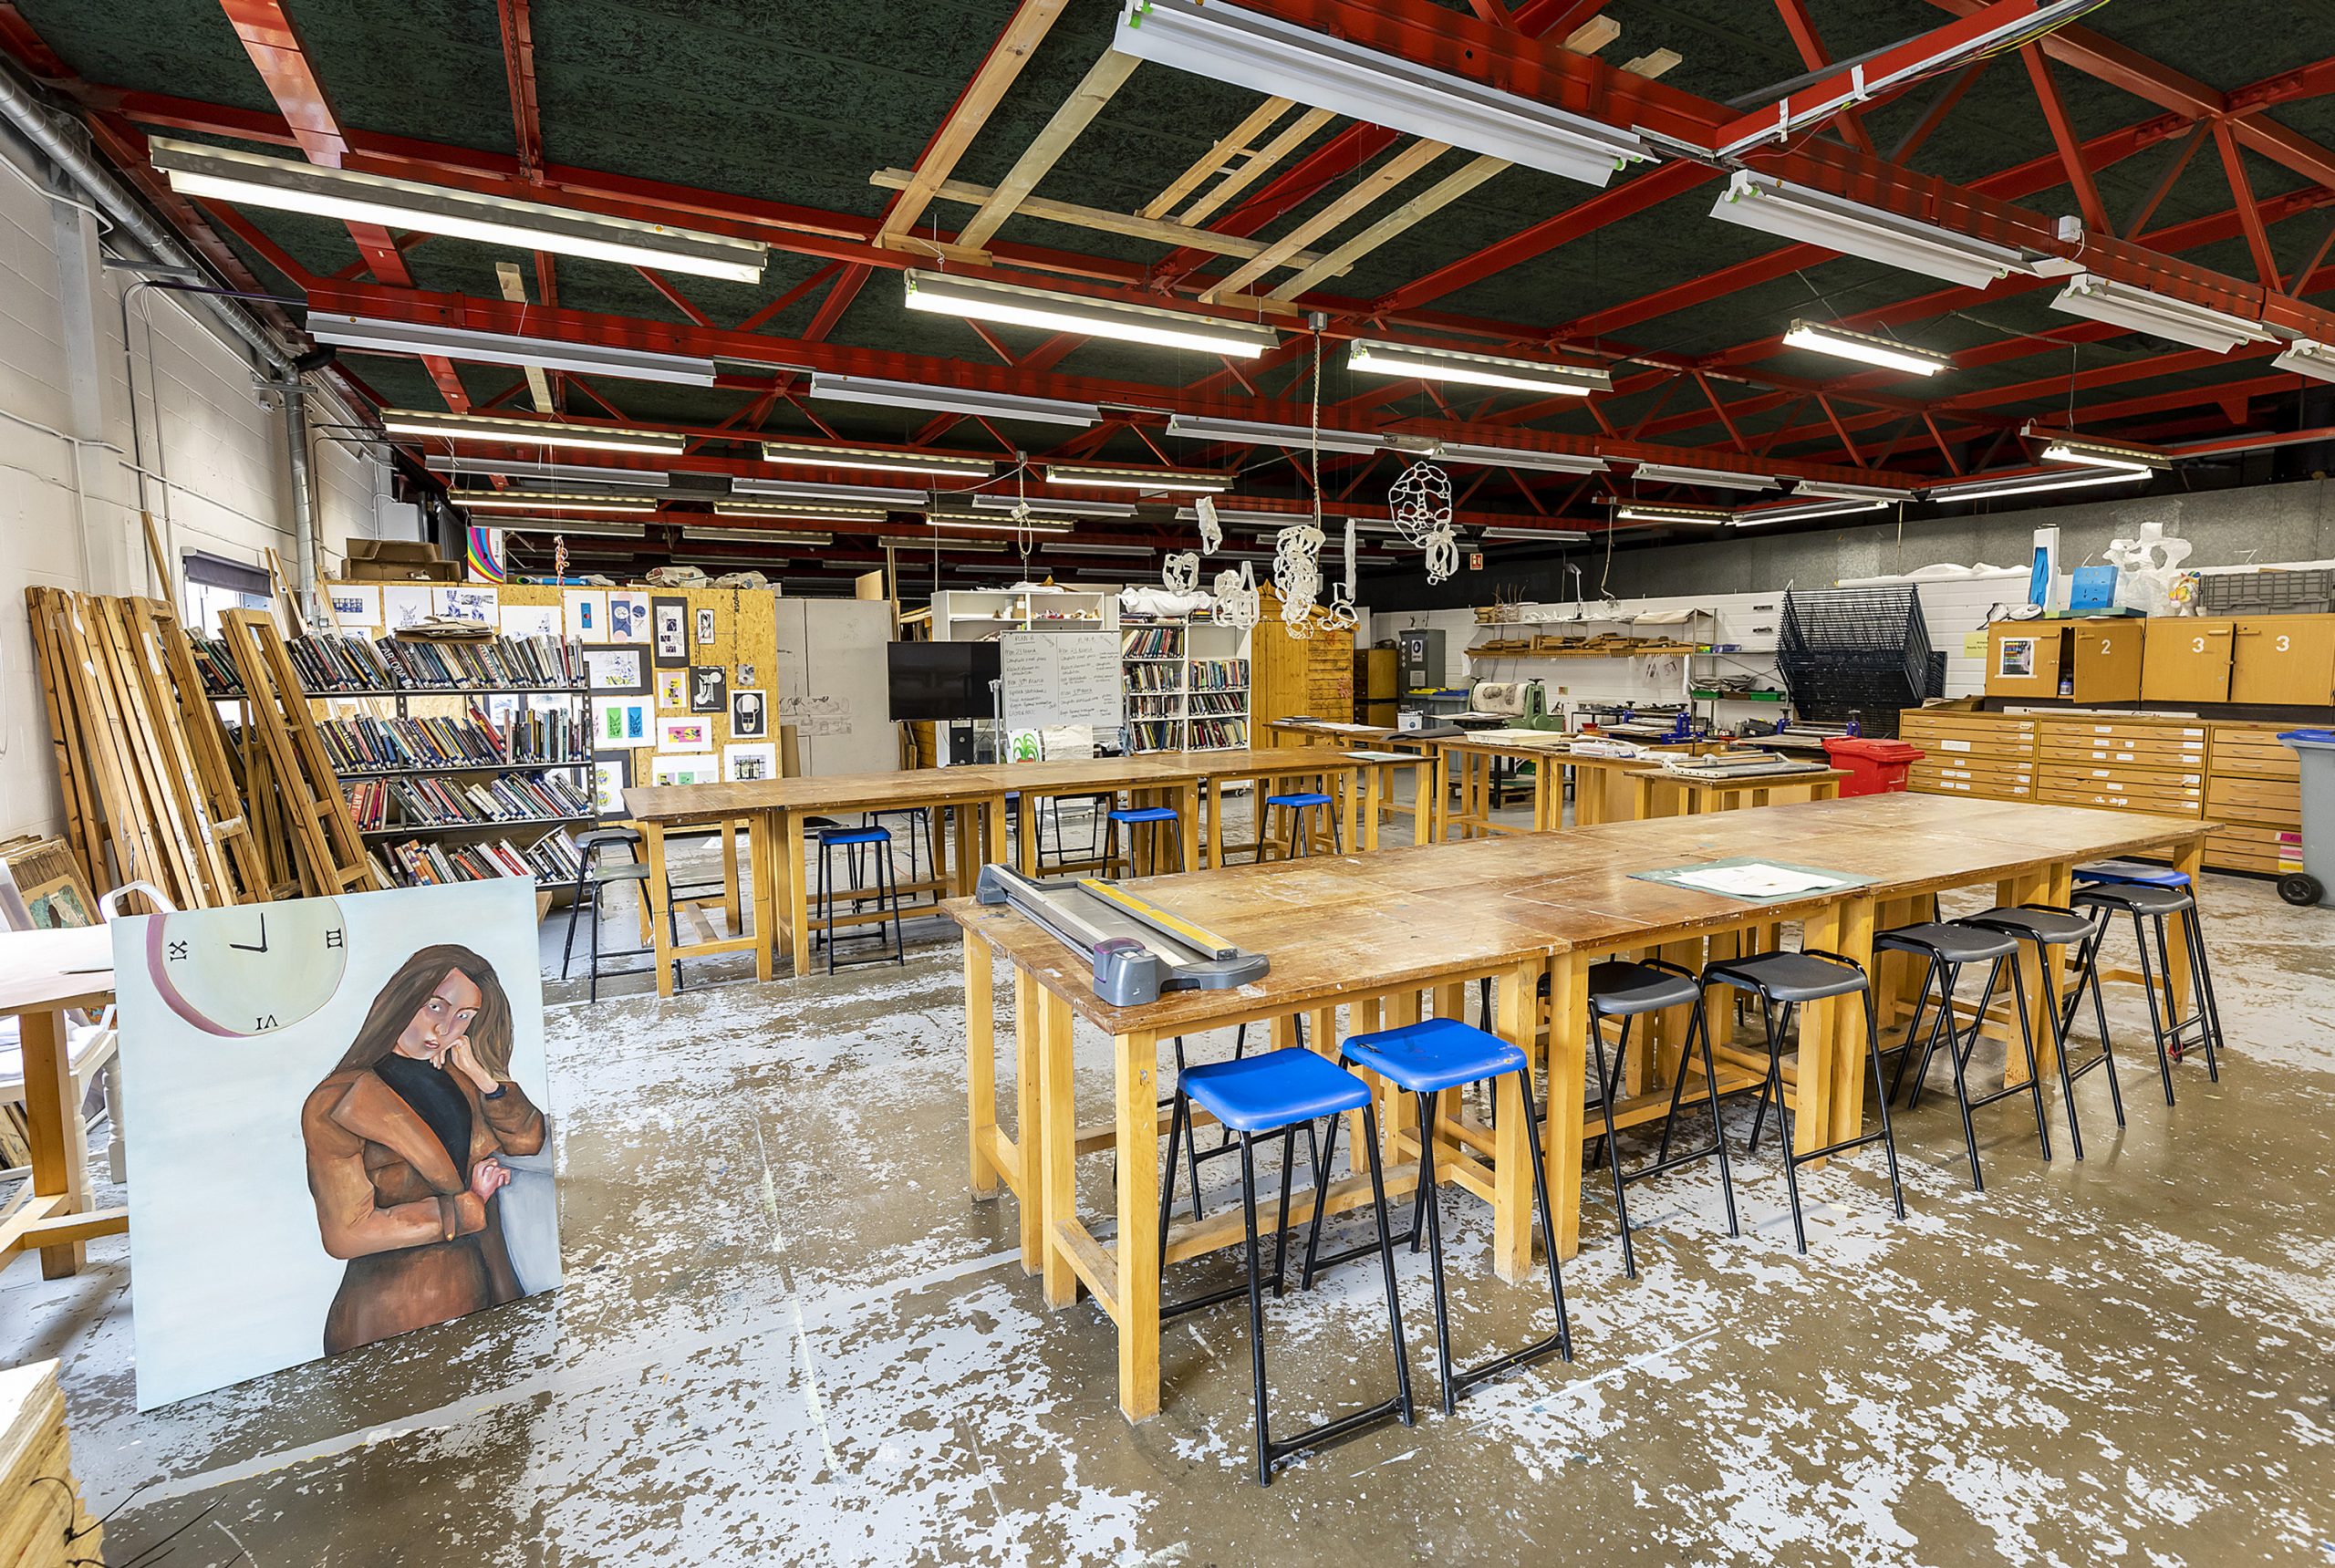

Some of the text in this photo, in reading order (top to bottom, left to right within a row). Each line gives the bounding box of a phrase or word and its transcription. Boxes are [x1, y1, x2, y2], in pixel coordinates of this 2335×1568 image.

[2101, 639, 2112, 655] 2
[2192, 637, 2205, 653] 3
[2276, 635, 2289, 652] 3
[342, 732, 356, 750] KLIMT
[352, 793, 363, 810] ART
[168, 940, 188, 962] IX
[254, 1014, 279, 1030] VI
